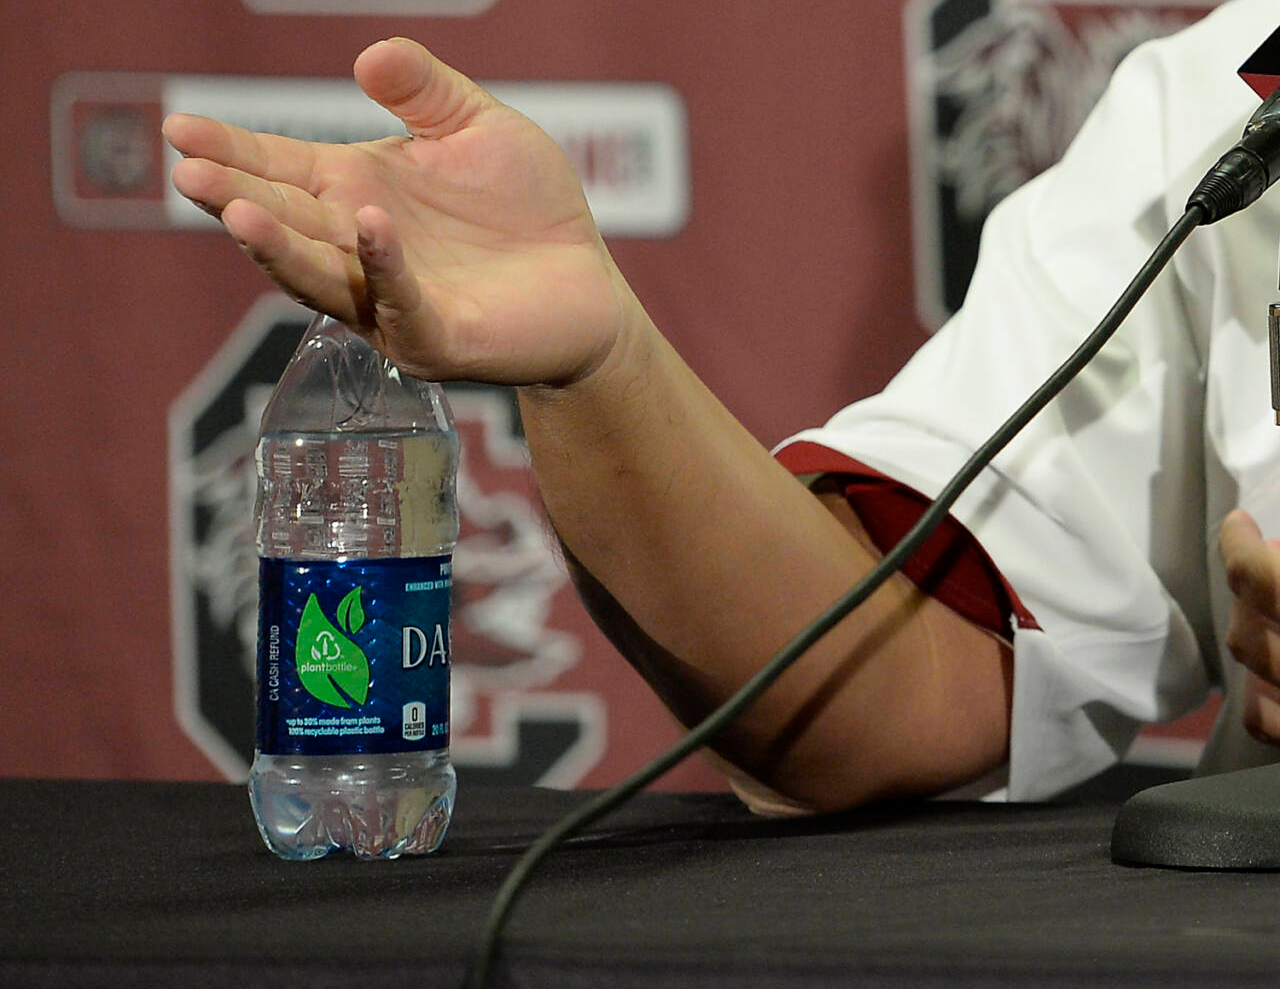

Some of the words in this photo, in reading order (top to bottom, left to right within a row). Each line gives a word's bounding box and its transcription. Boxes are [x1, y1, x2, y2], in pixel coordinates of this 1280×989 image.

[269, 625, 280, 661] REFUND
[269, 662, 280, 687] CASH
[269, 688, 280, 702] CA
[358, 716, 381, 726] plants
[412, 707, 418, 722] 0
